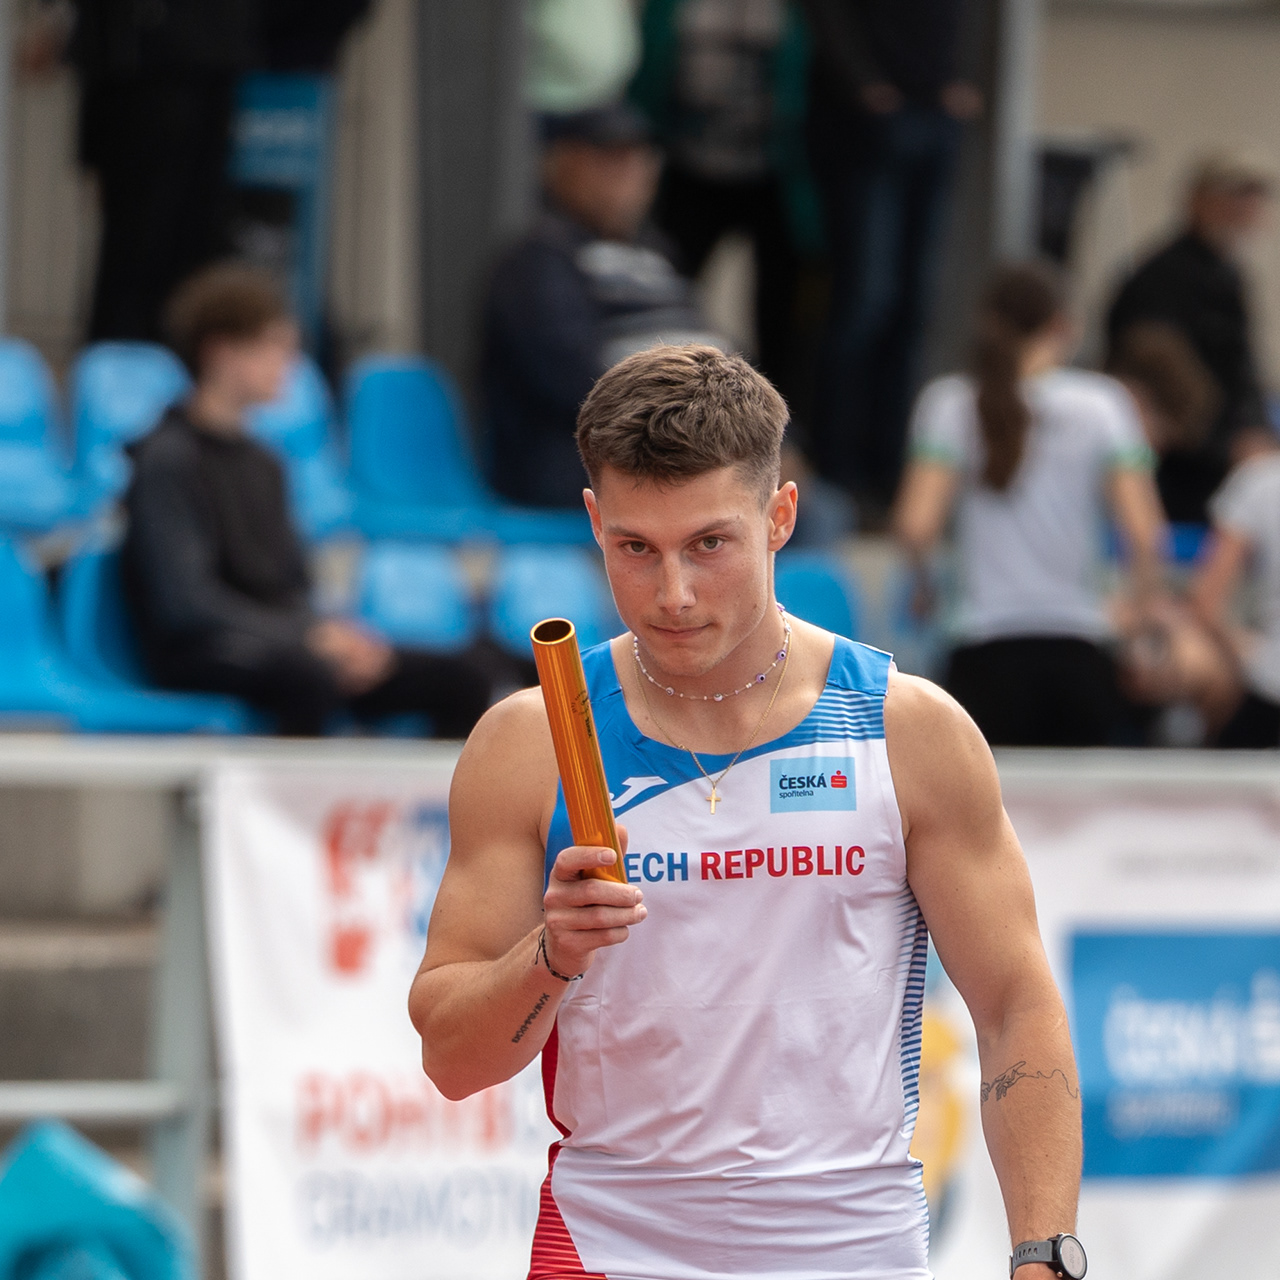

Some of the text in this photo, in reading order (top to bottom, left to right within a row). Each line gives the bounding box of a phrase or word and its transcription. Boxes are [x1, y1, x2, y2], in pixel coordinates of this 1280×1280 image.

[778, 772, 827, 790] ČESKÁ
[778, 789, 814, 799] spořitelna
[624, 845, 866, 883] ECH REPUBLIC
